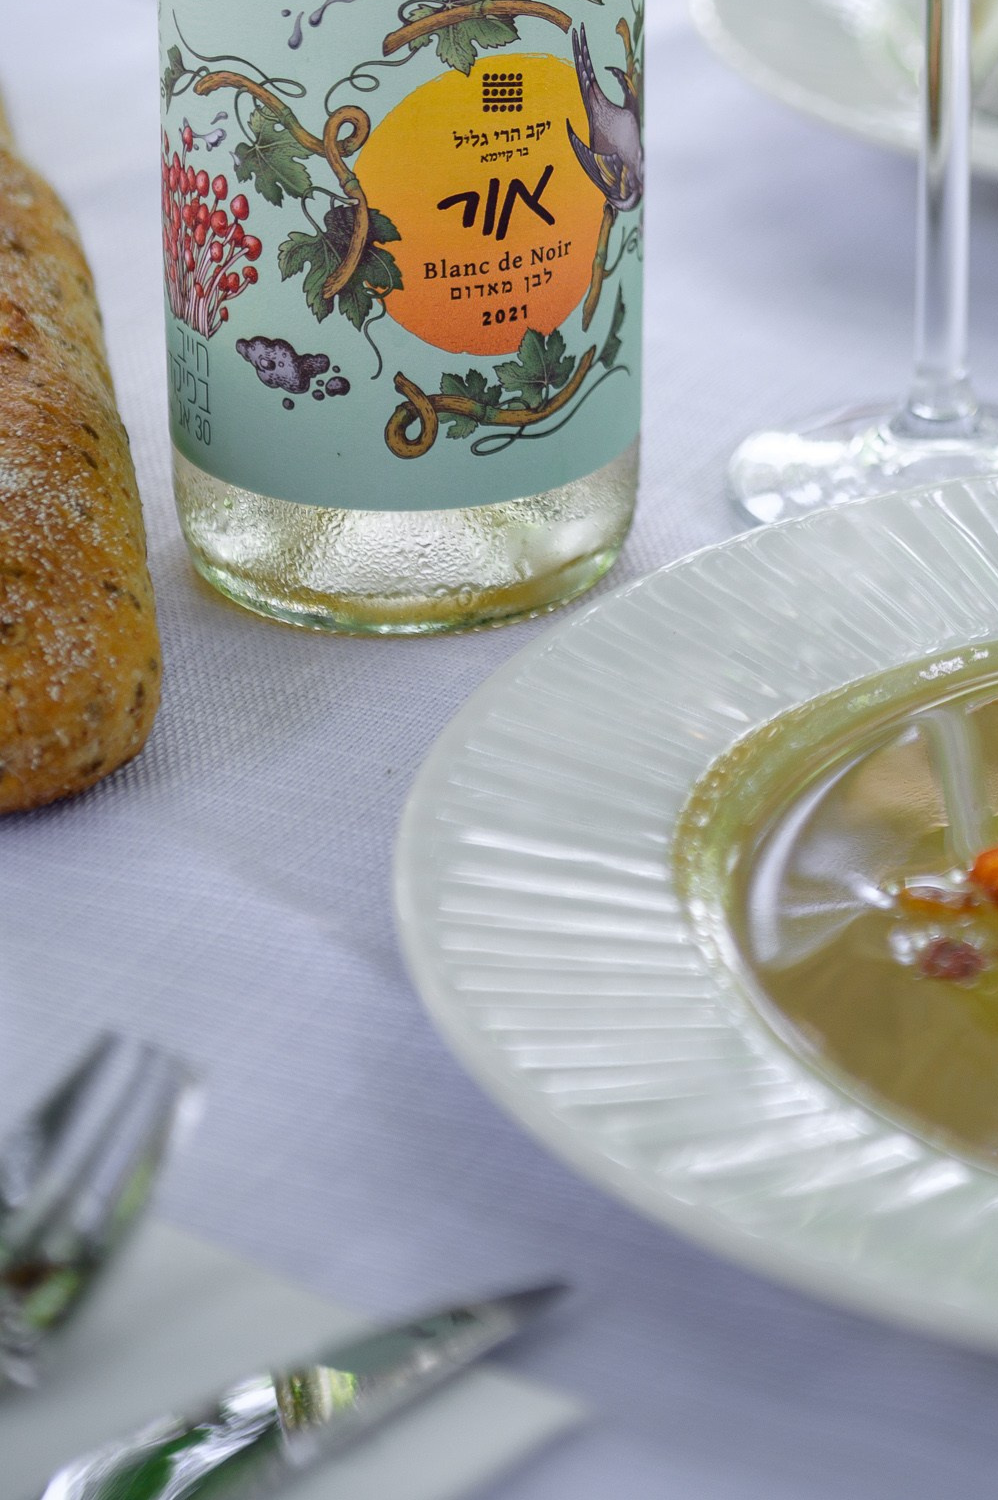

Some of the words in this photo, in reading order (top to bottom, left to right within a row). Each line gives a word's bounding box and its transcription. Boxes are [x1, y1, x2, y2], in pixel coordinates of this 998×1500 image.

[452, 129, 489, 149] גליל
[493, 127, 521, 143] הרי
[525, 120, 551, 141] יקב
[480, 149, 513, 163] קיימא
[516, 147, 529, 157] בר
[437, 164, 555, 241] אור
[423, 258, 490, 279] Blanc
[498, 251, 523, 271] de
[530, 240, 572, 265] Noir
[450, 279, 513, 300] מאדום
[524, 268, 553, 293] לבן
[482, 304, 528, 326] 2021
[177, 326, 209, 378] חייב
[195, 414, 211, 446] 30
